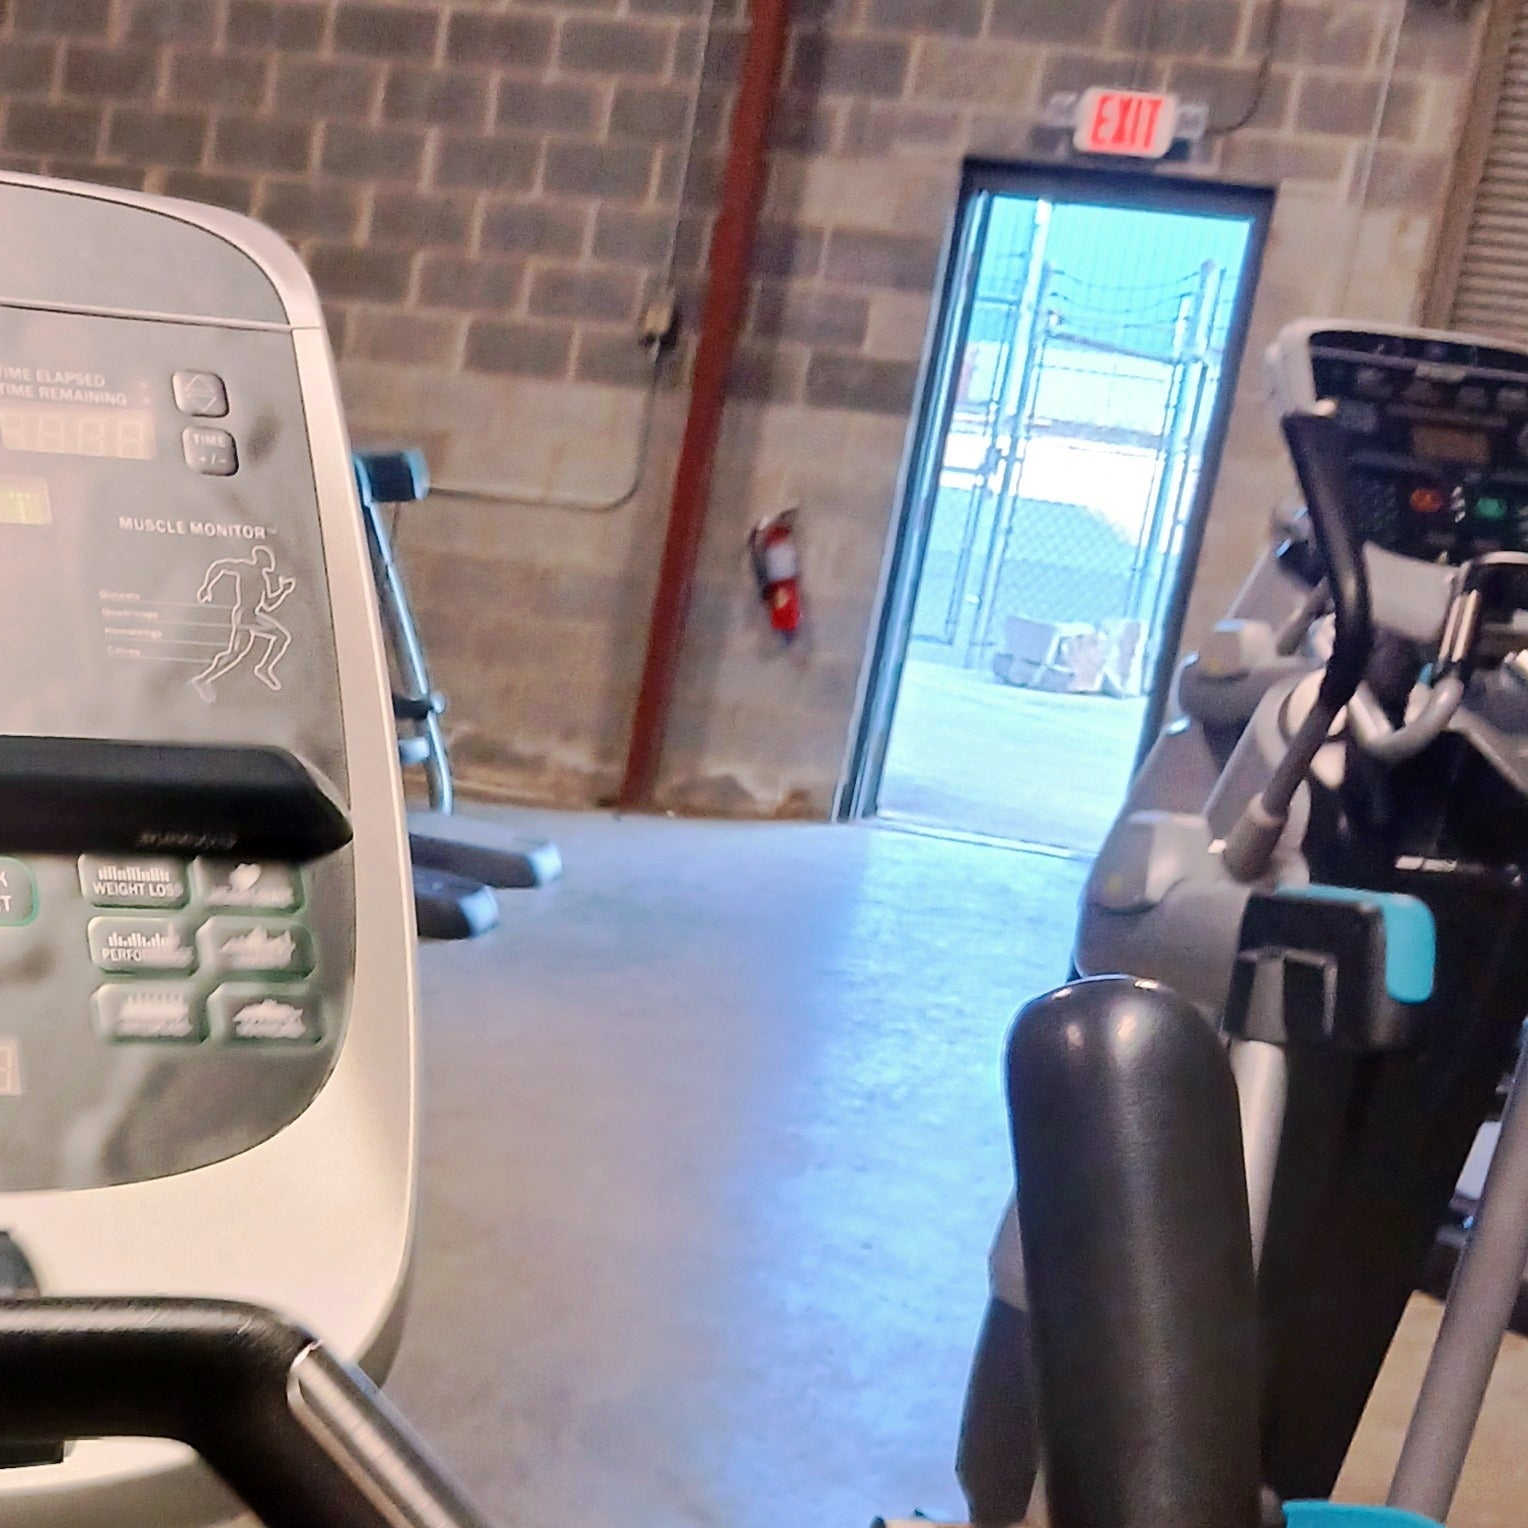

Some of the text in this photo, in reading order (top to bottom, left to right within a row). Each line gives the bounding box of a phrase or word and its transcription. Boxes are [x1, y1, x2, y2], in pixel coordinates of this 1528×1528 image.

[1089, 94, 1164, 150] EXIT
[36, 369, 106, 388] ELAPSED
[39, 385, 127, 407] REMAINING
[191, 432, 226, 448] TIME
[118, 516, 187, 535] MUSCLE
[92, 881, 145, 897] WEIGHT
